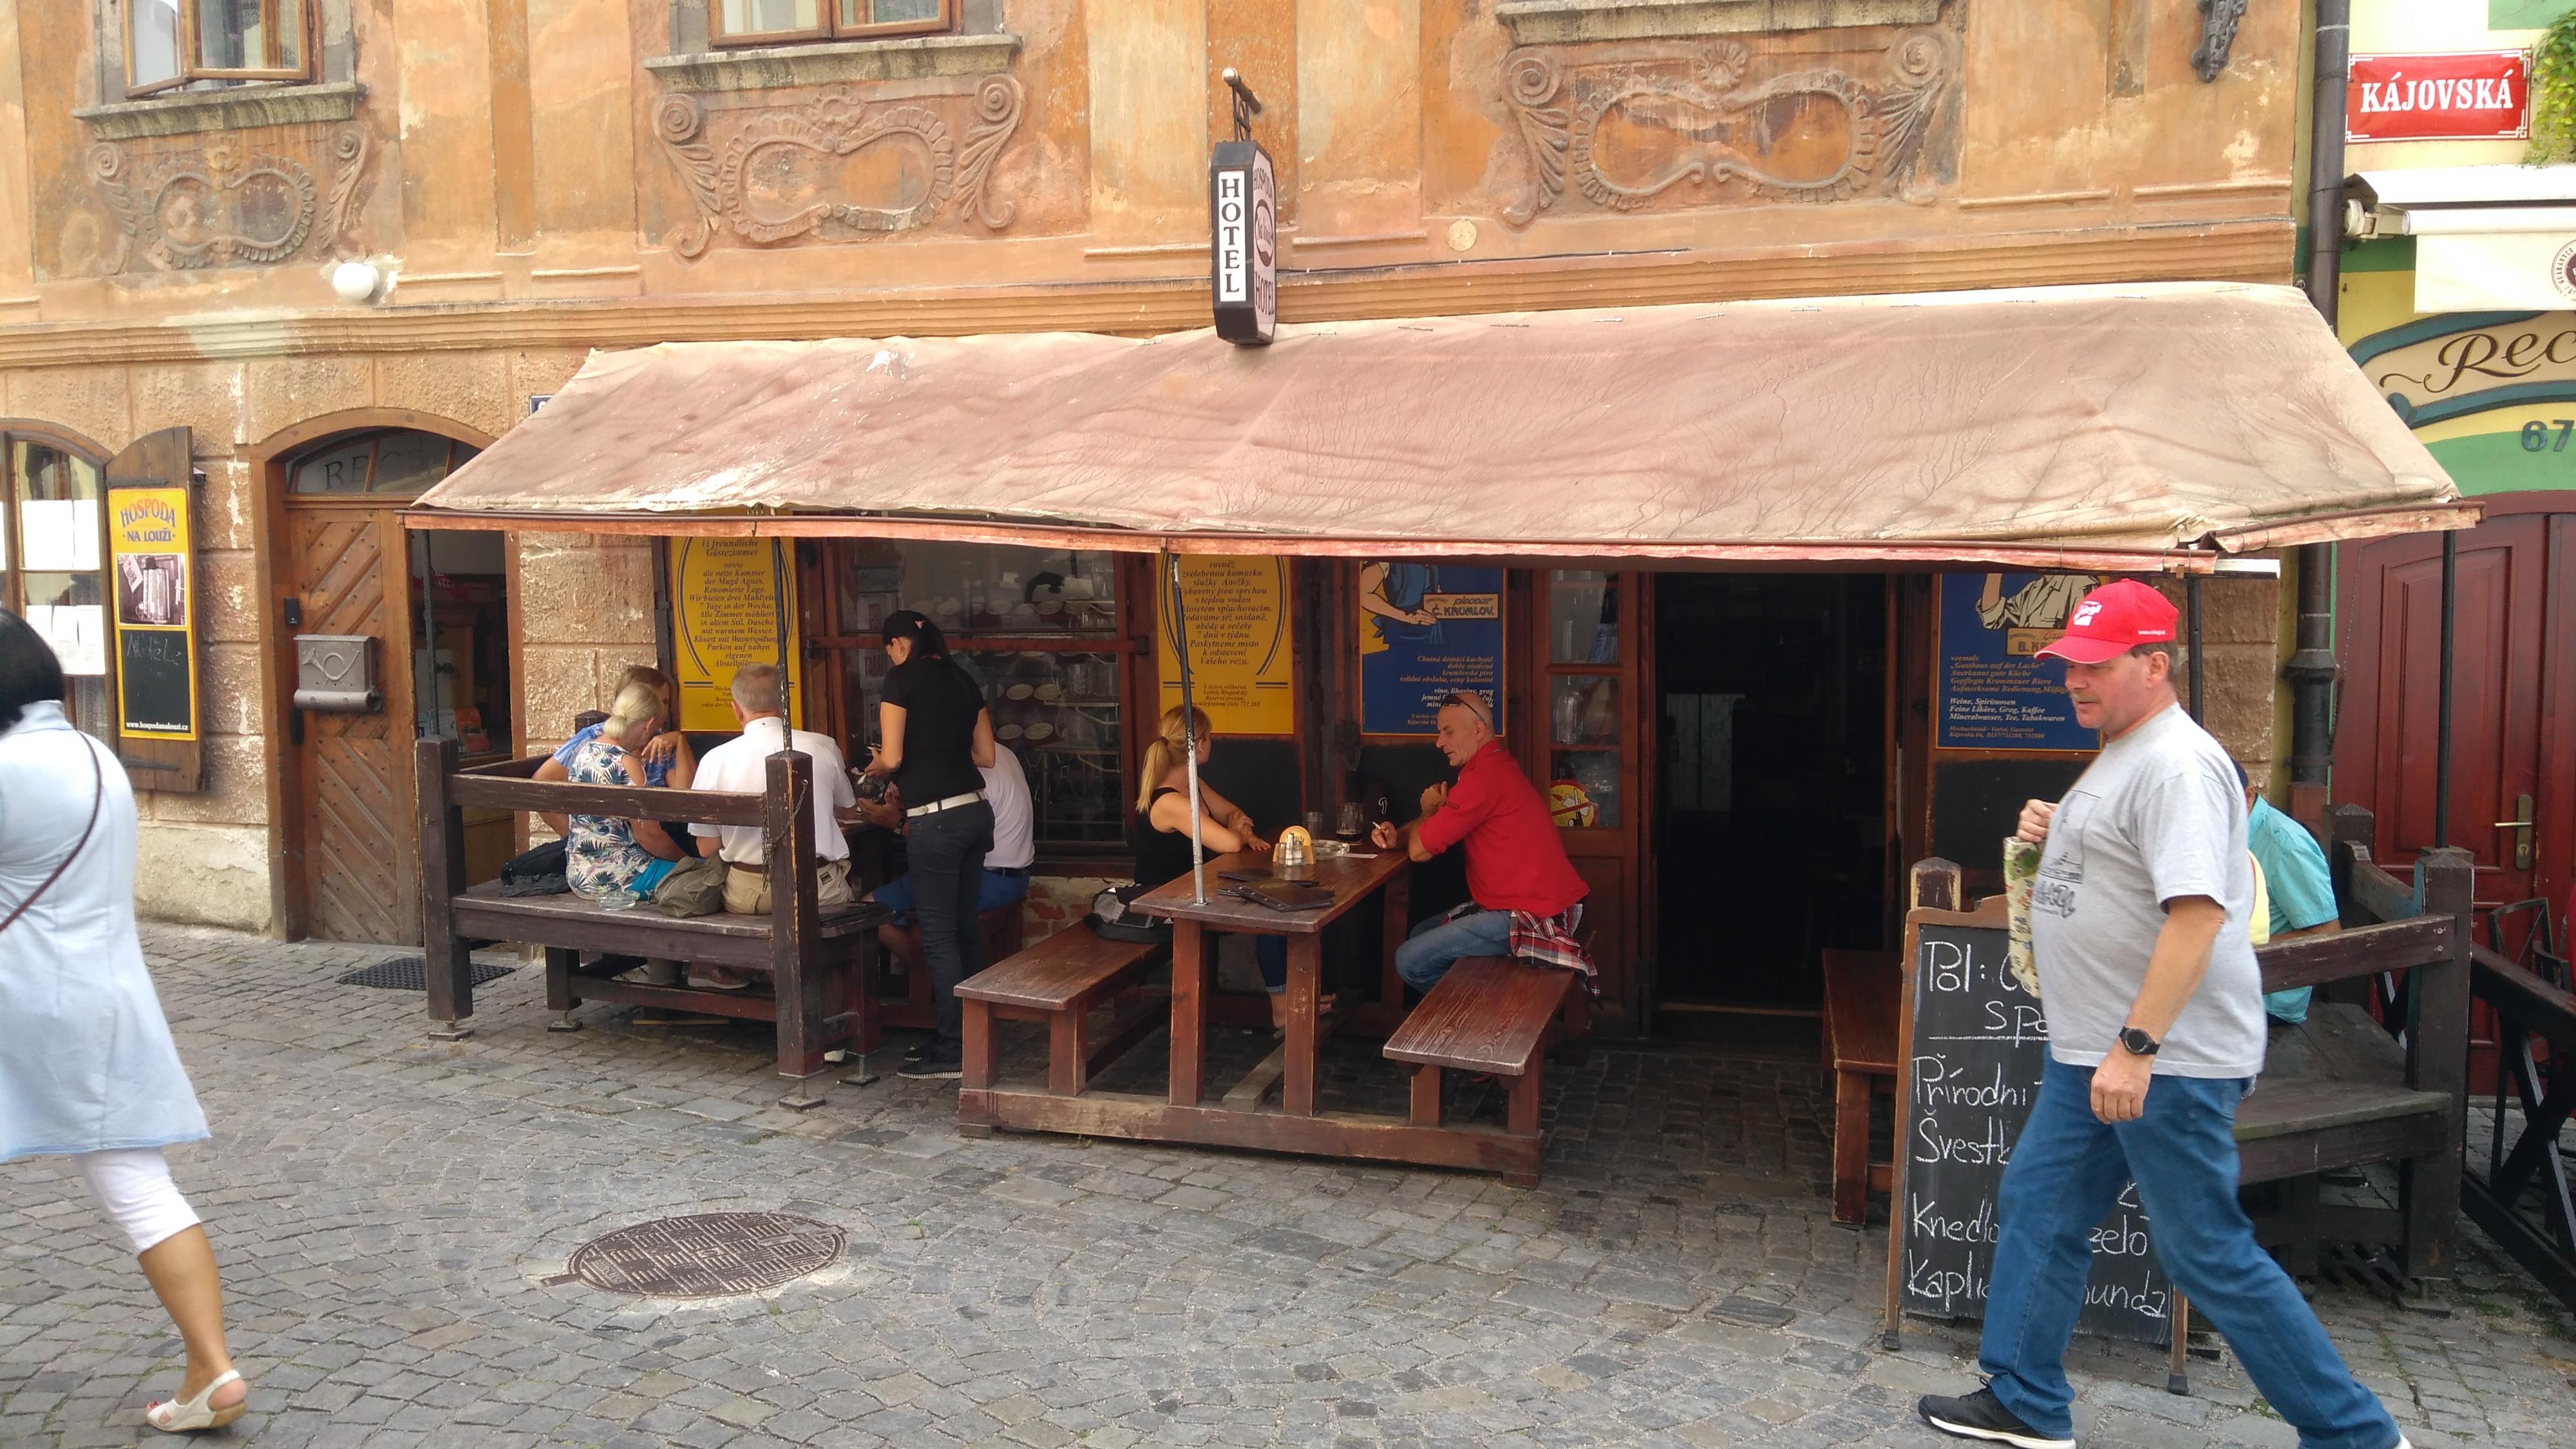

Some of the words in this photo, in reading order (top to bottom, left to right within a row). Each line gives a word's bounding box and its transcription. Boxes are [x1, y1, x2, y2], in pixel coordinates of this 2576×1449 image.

[2360, 69, 2514, 114] KÁJOVSKÁ
[1221, 178, 1241, 293] HOTEL
[1255, 270, 1274, 316] HOTEL
[2522, 419, 2575, 451] 67
[120, 498, 176, 529] HOSPODA
[128, 531, 141, 542] NA
[144, 527, 171, 542] LOUŽI
[711, 538, 759, 549] freundliche
[1182, 569, 1225, 578] zvelebenou
[1217, 587, 1233, 596] jsou
[1236, 587, 1267, 598] sprchou
[1201, 596, 1225, 605] teplou
[715, 610, 742, 618] Zimmer
[1444, 606, 1495, 616] KRUMLOV.
[1195, 622, 1218, 632] obědy
[734, 643, 747, 652] auf
[1190, 639, 1236, 649] Poskytneme
[725, 652, 752, 660] eigenen
[1209, 648, 1247, 656] odstavení
[1200, 656, 1227, 665] Vašeho
[1975, 698, 2016, 706] Spirituosen
[1949, 713, 2003, 721] Mineralwasser,
[126, 721, 189, 731] www.hospodanalouzi.cz
